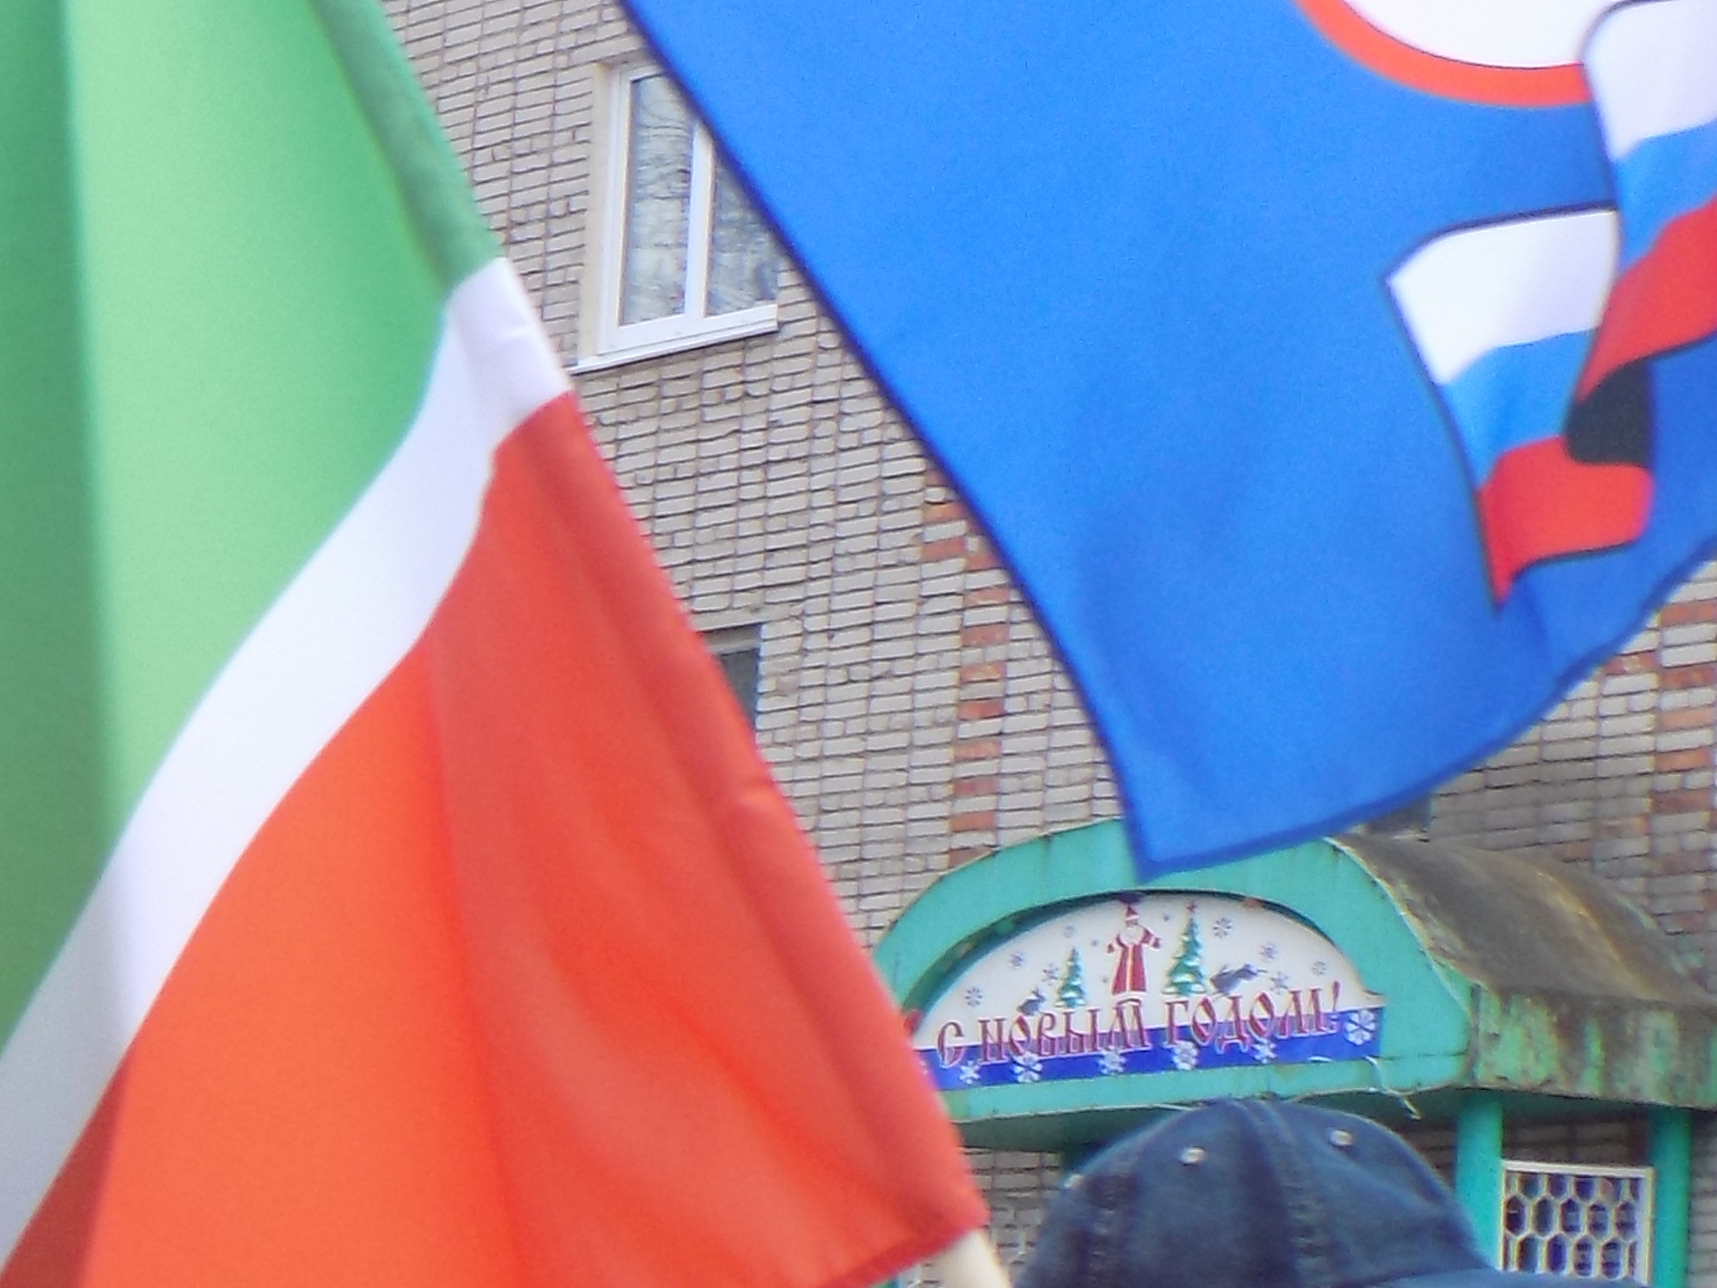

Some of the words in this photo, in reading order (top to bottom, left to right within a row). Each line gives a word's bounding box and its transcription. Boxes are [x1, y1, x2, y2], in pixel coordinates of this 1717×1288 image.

[936, 1019, 965, 1068] С
[977, 998, 1151, 1066] НОВЫМ
[1164, 979, 1344, 1054] ГОДОМ!
